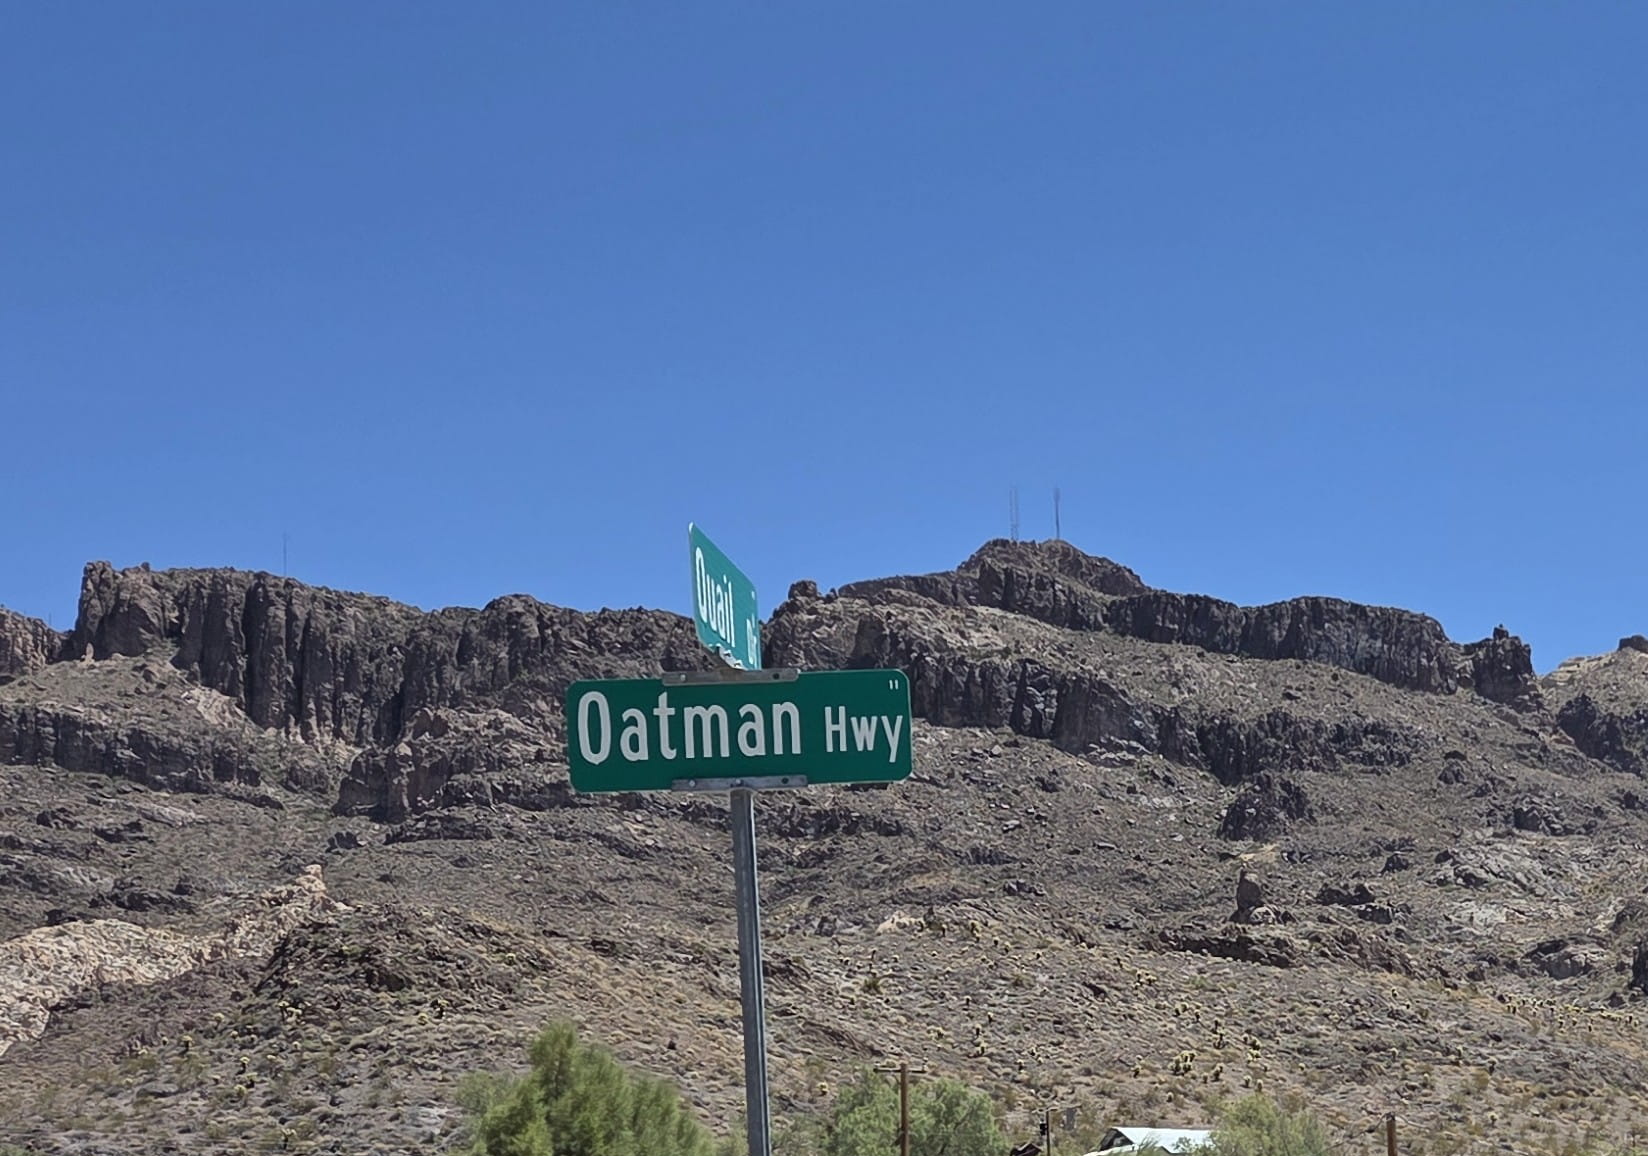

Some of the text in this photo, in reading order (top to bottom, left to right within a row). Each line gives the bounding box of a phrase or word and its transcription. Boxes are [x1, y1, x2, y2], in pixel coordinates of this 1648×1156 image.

[695, 546, 736, 648] Quail
[577, 690, 903, 766] Oatman Hwy
